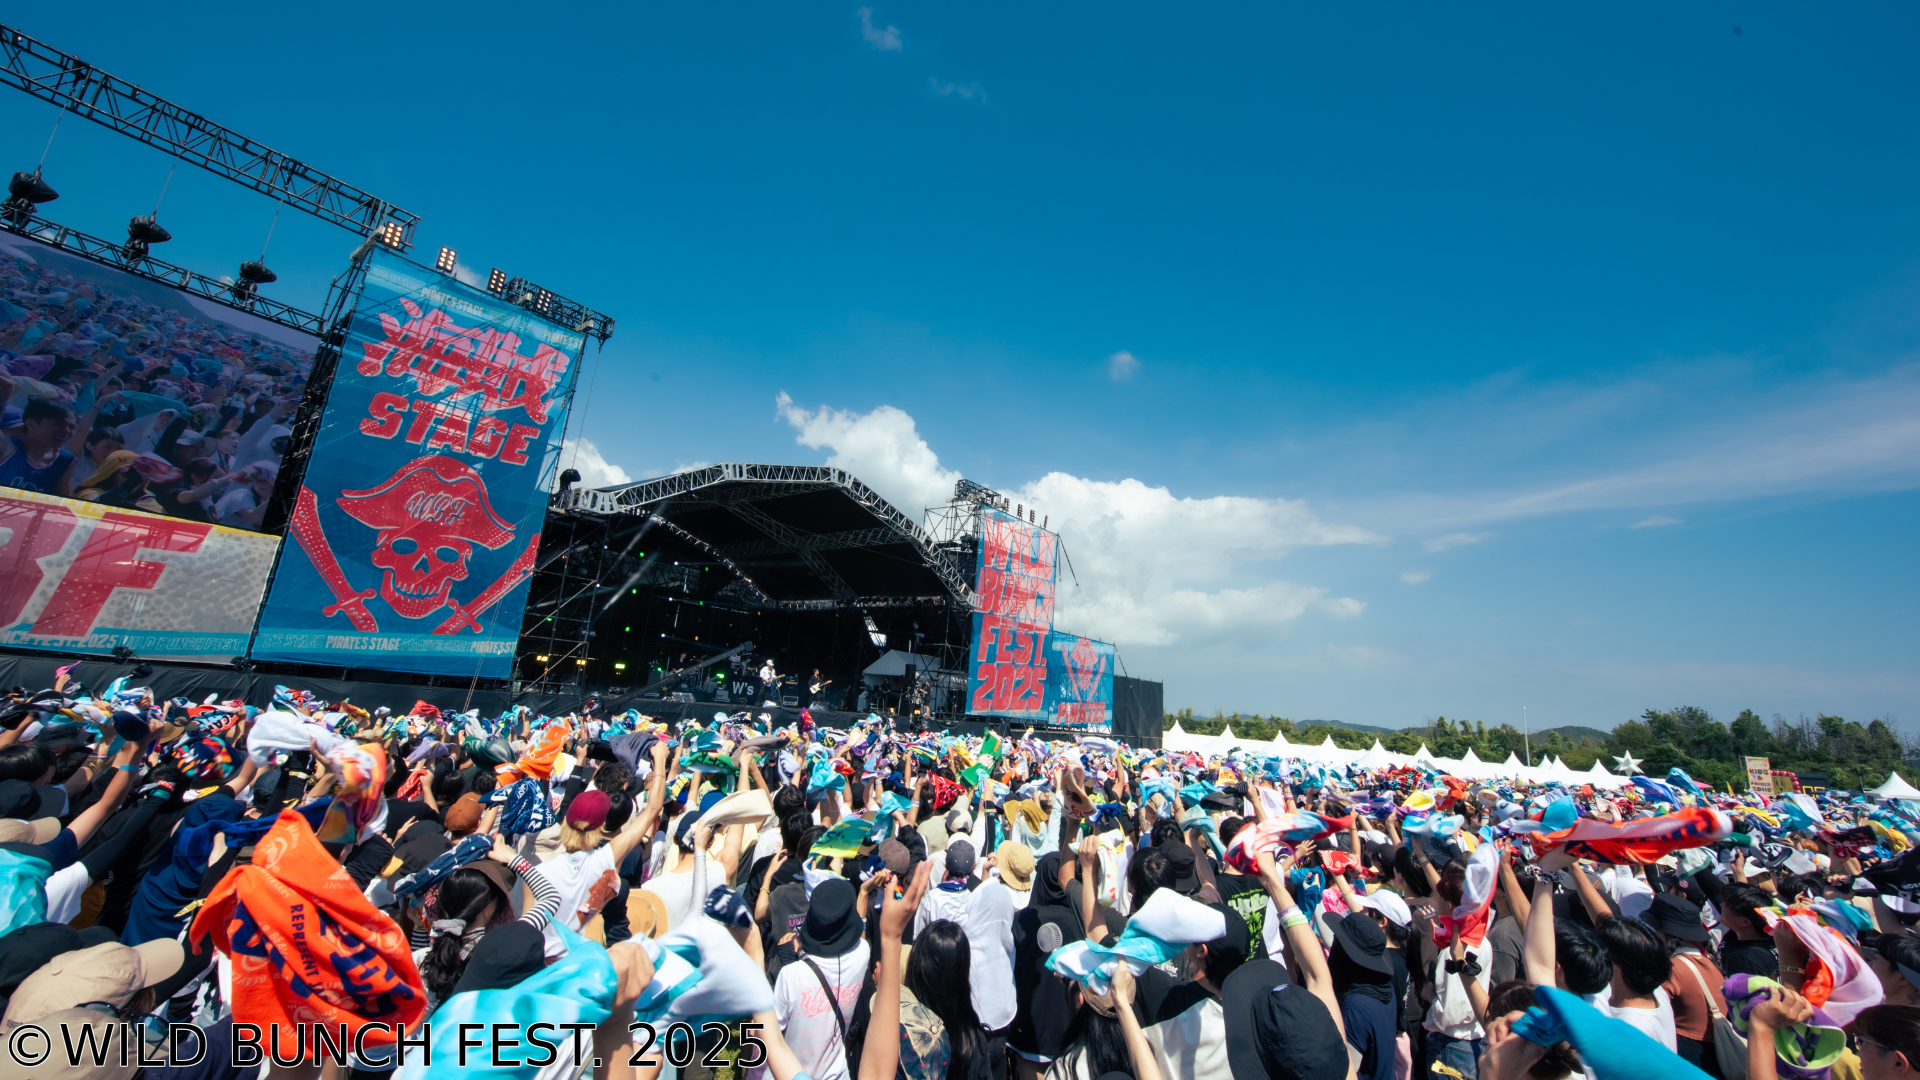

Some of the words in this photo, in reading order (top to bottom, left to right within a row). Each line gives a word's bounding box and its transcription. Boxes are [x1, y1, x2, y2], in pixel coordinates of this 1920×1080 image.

[455, 299, 485, 317] STAGE
[358, 391, 542, 466] STAGE
[404, 490, 476, 526] WBF
[984, 515, 1057, 580] WILD
[973, 566, 1055, 623] BUNCH
[155, 637, 206, 651] BUNCH
[203, 637, 246, 652] FEST.
[283, 634, 325, 649] STAGE
[325, 635, 369, 650] PIRATES
[368, 637, 401, 651] STAGE
[400, 638, 443, 652] PIRATES
[469, 640, 505, 654] PIRATES
[977, 614, 1050, 667] FEST.
[731, 680, 755, 696] W's
[971, 662, 1048, 712] 2025
[1056, 701, 1107, 725] PIRATES
[1749, 768, 1769, 776] KIDS
[289, 903, 320, 979] REPRESENT
